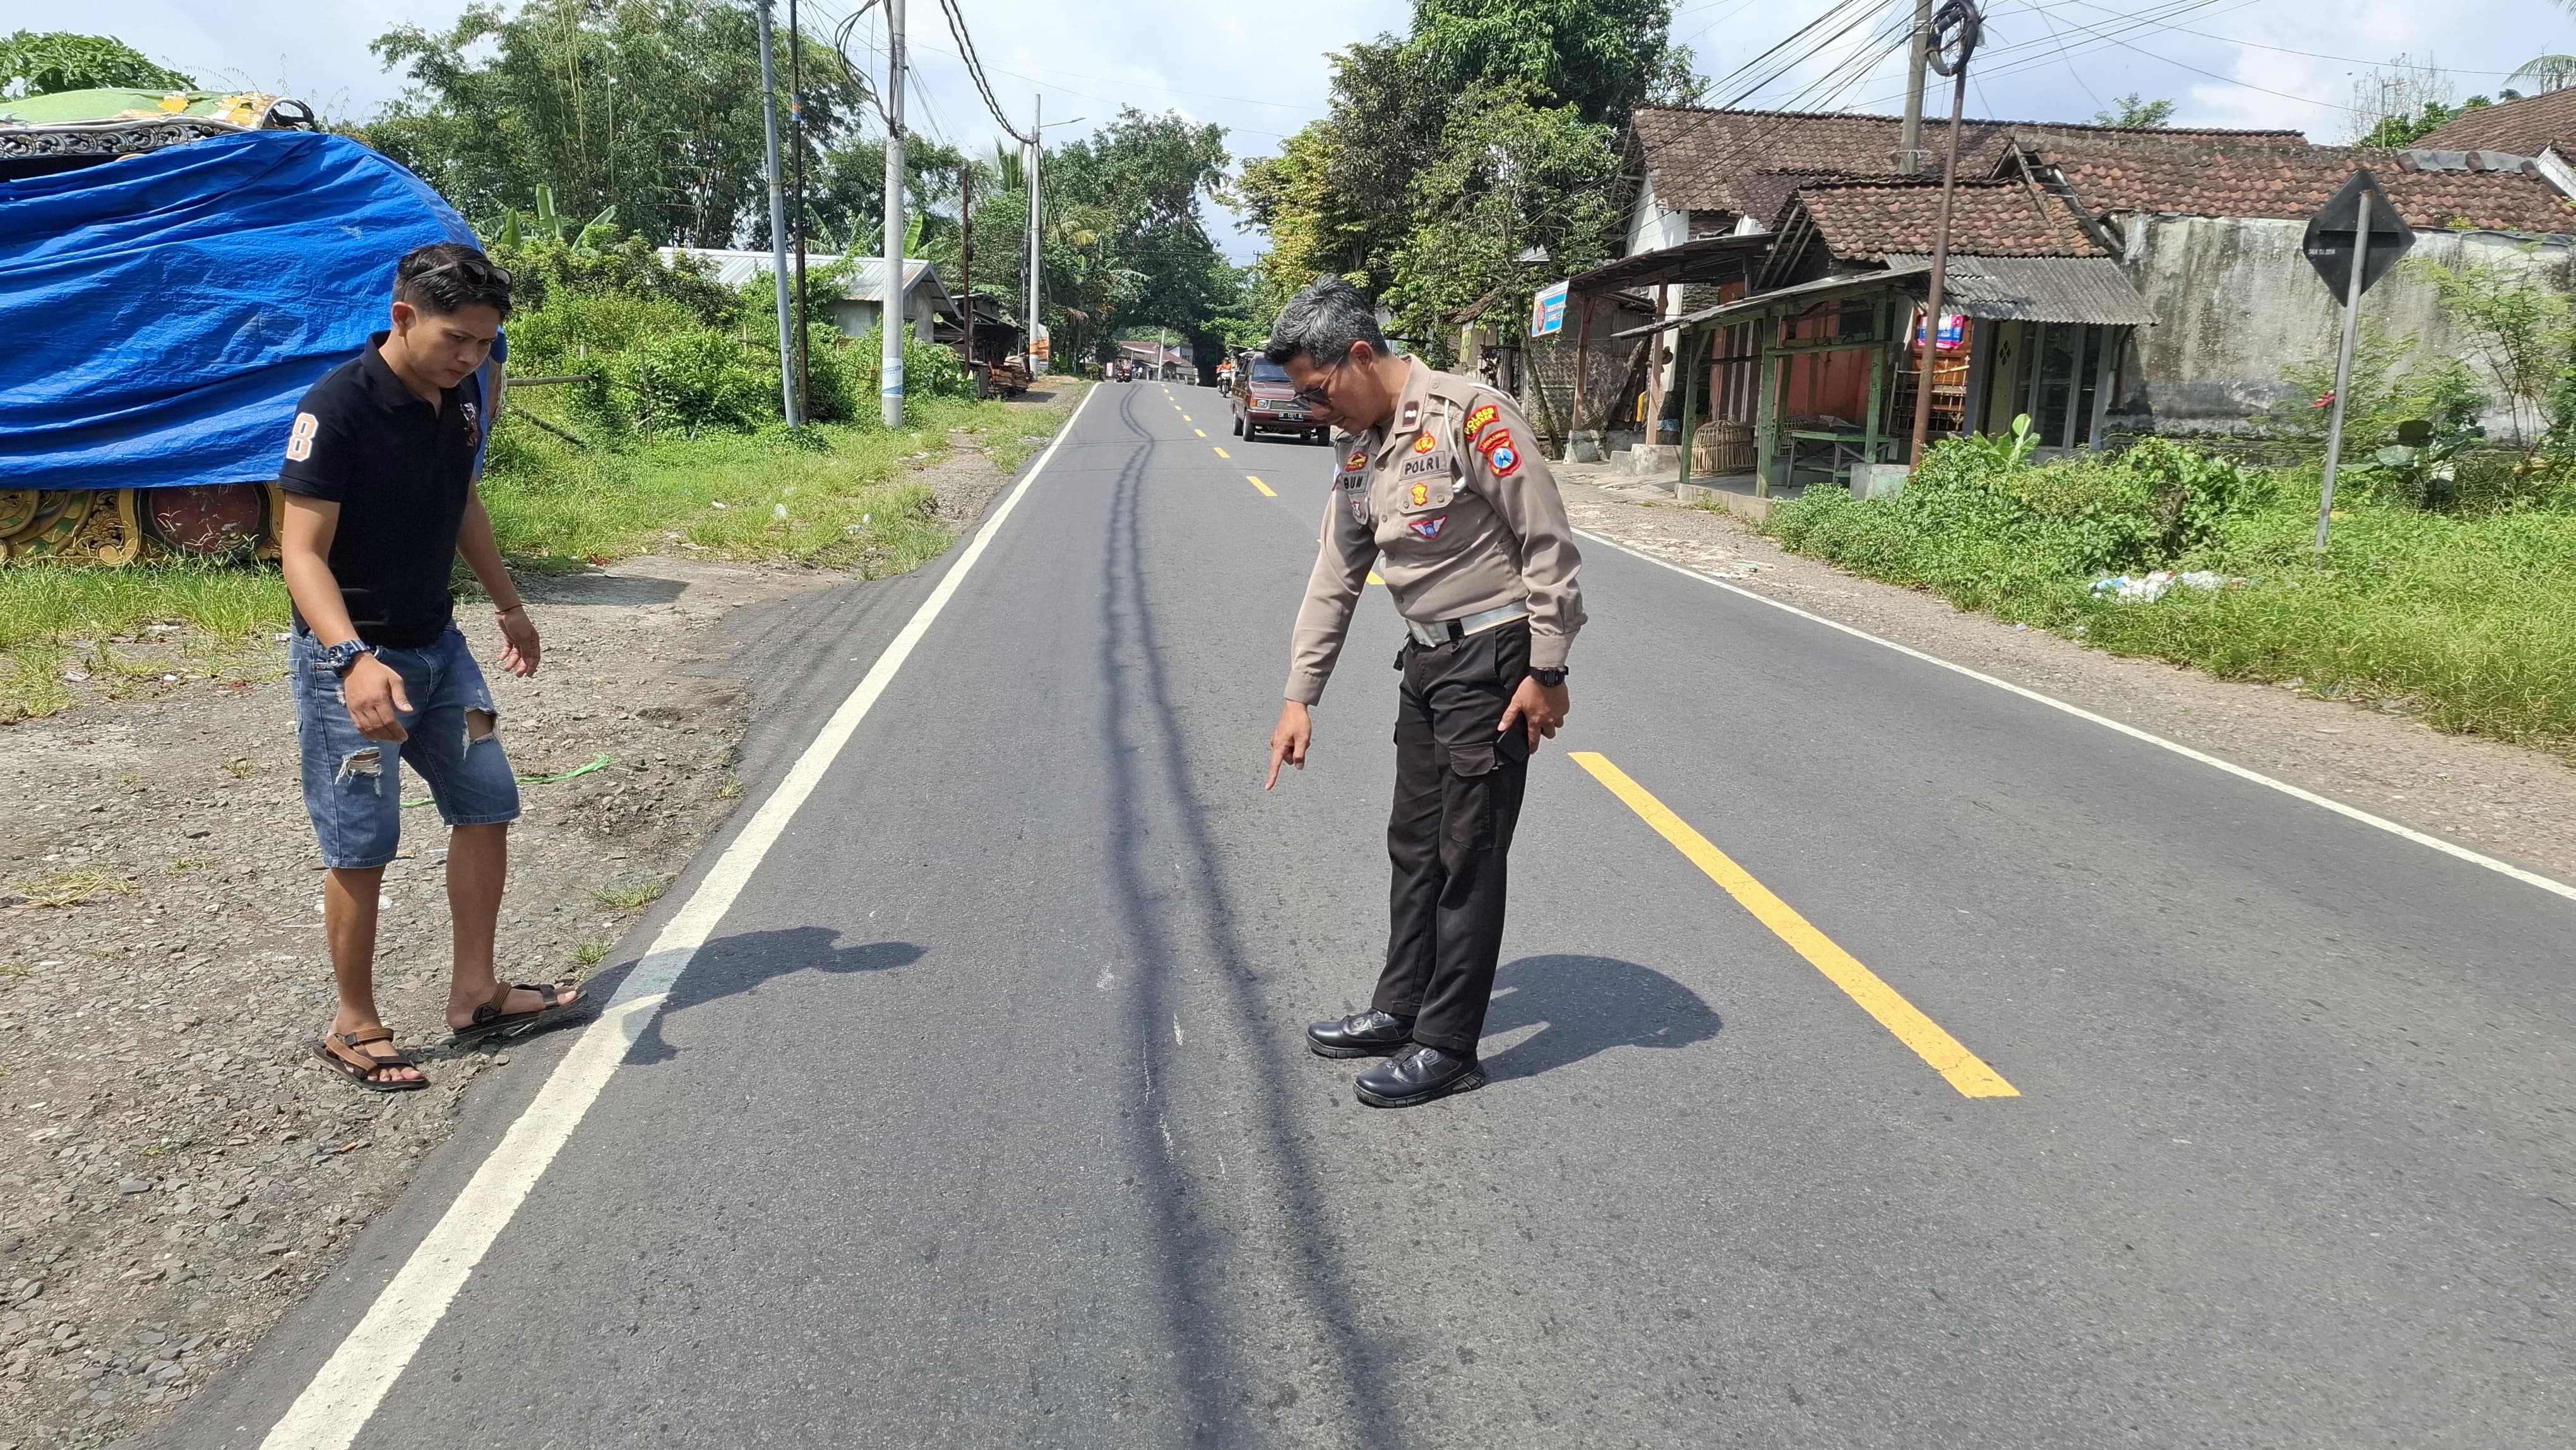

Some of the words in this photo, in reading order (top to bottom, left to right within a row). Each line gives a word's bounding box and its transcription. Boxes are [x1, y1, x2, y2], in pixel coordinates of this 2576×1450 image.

[1464, 407, 1495, 434] POLRES
[1470, 414, 1493, 433] JEMBER
[286, 412, 319, 462] 8
[1404, 456, 1440, 476] POLRI
